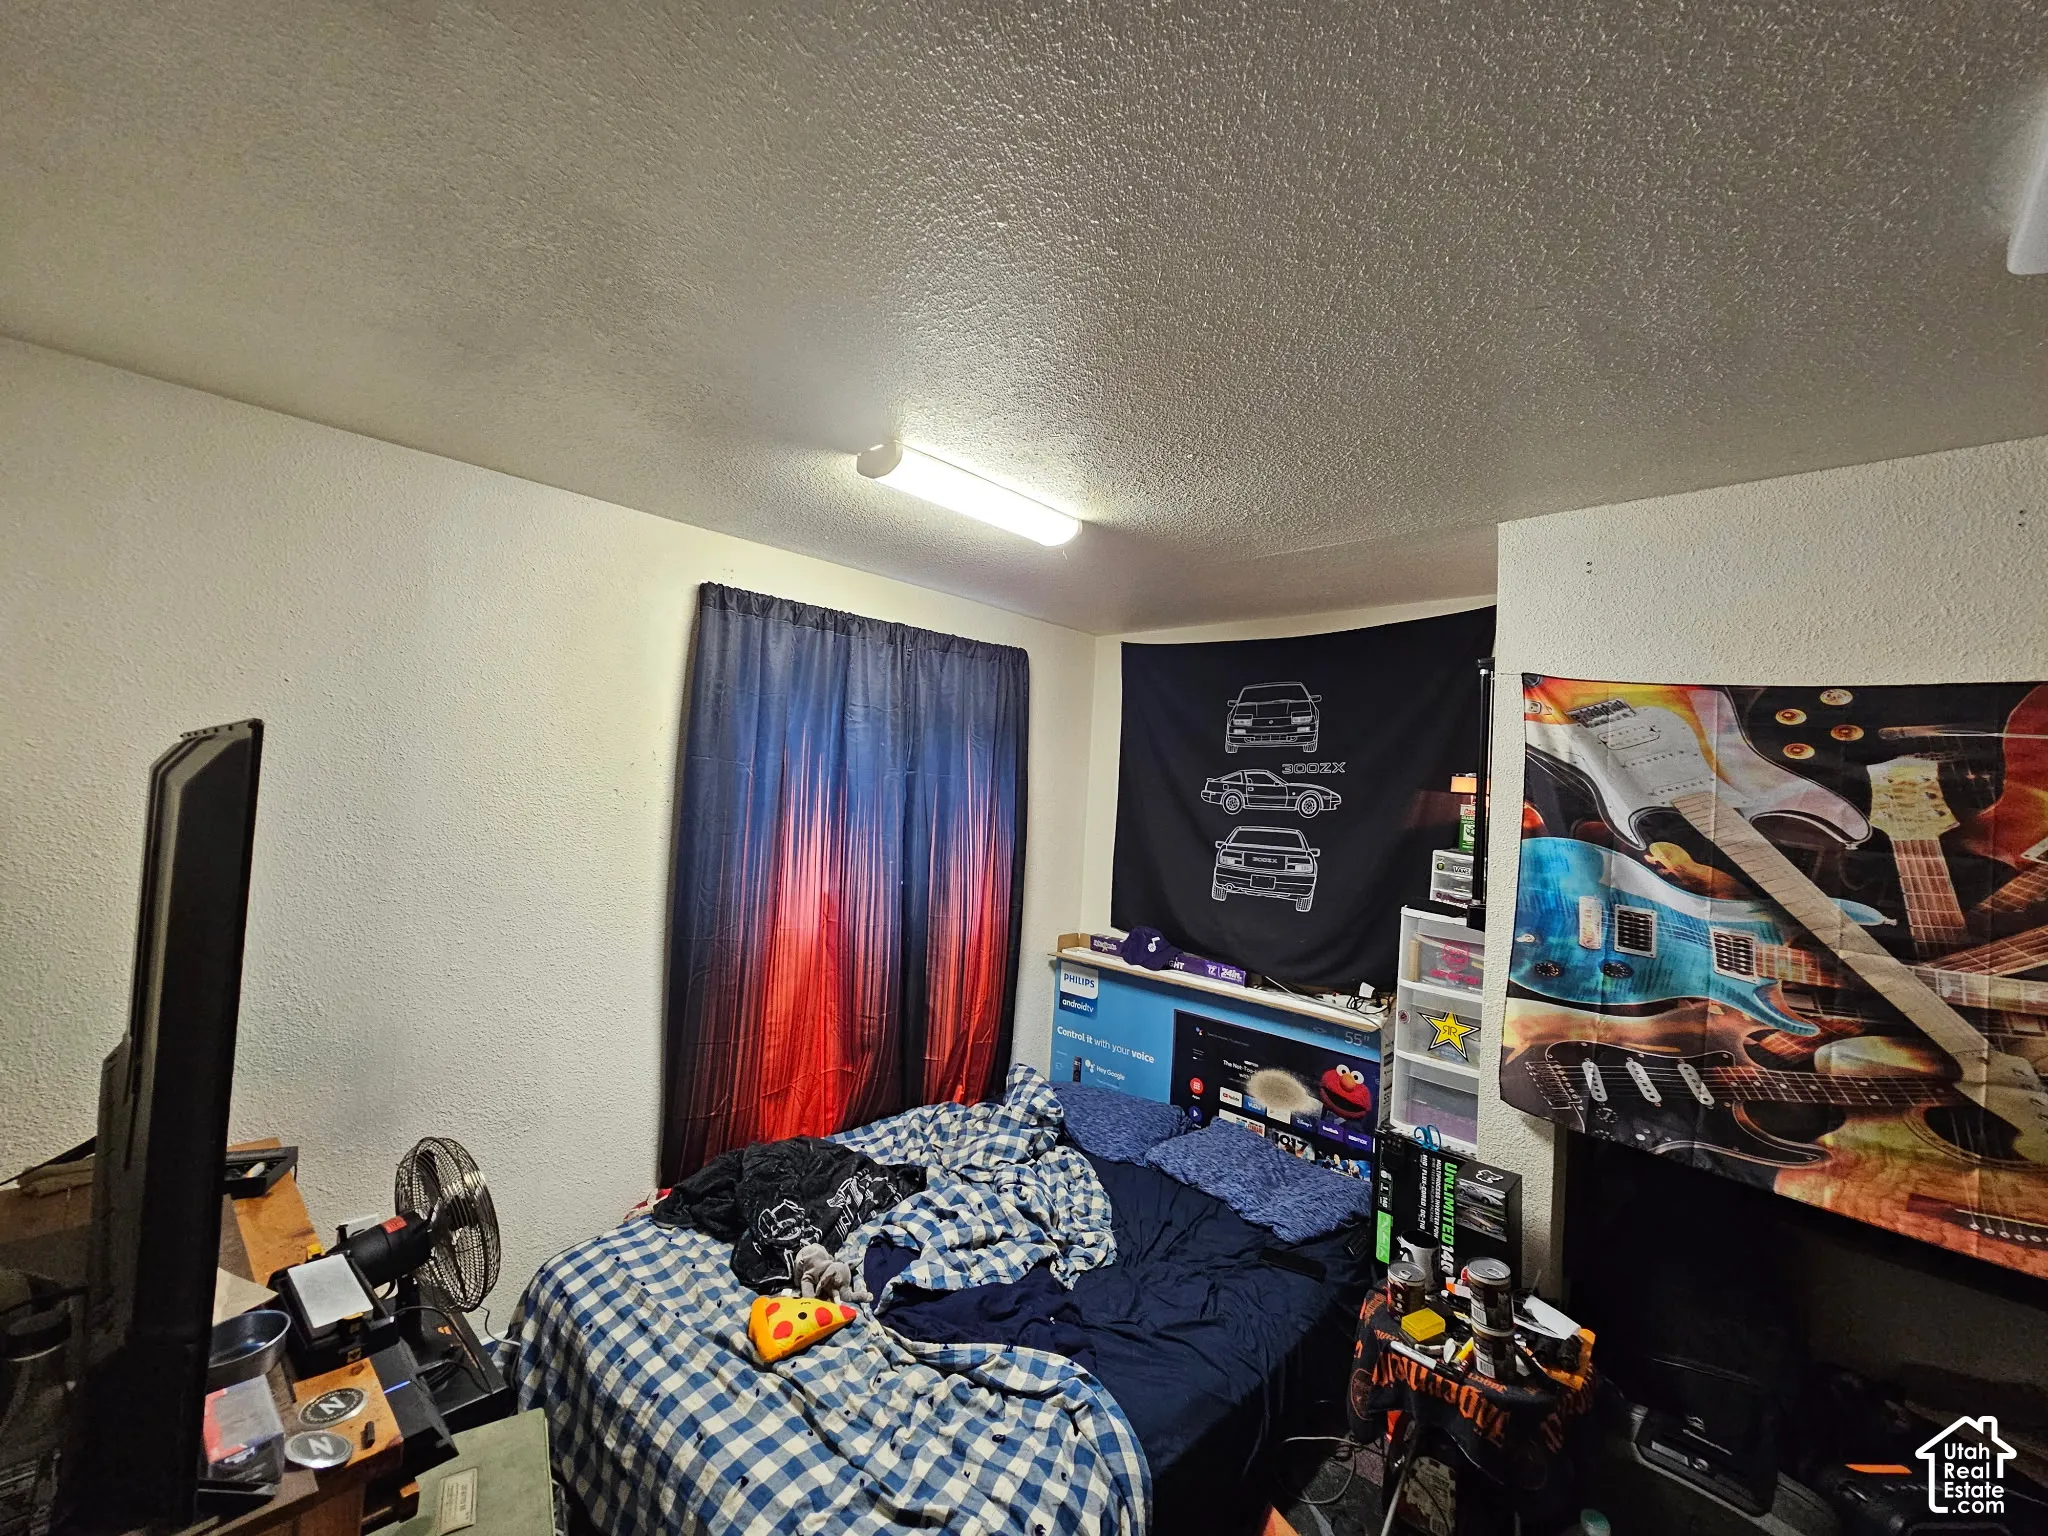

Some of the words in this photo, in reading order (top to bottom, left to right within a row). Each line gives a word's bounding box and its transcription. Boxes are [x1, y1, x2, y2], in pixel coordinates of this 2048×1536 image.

[1282, 762, 1346, 774] 300ZX
[1252, 856, 1278, 864] 300ZX
[1064, 973, 1095, 988] PHILIPS
[1057, 1026, 1085, 1042] Control
[1086, 1035, 1092, 1044] it
[1094, 1038, 1110, 1049] with
[1112, 1044, 1130, 1056] your
[1131, 1049, 1155, 1064] voice
[1096, 1066, 1106, 1075] Hey
[1107, 1070, 1125, 1081] Google
[1441, 1162, 1457, 1245] UNLIMITED
